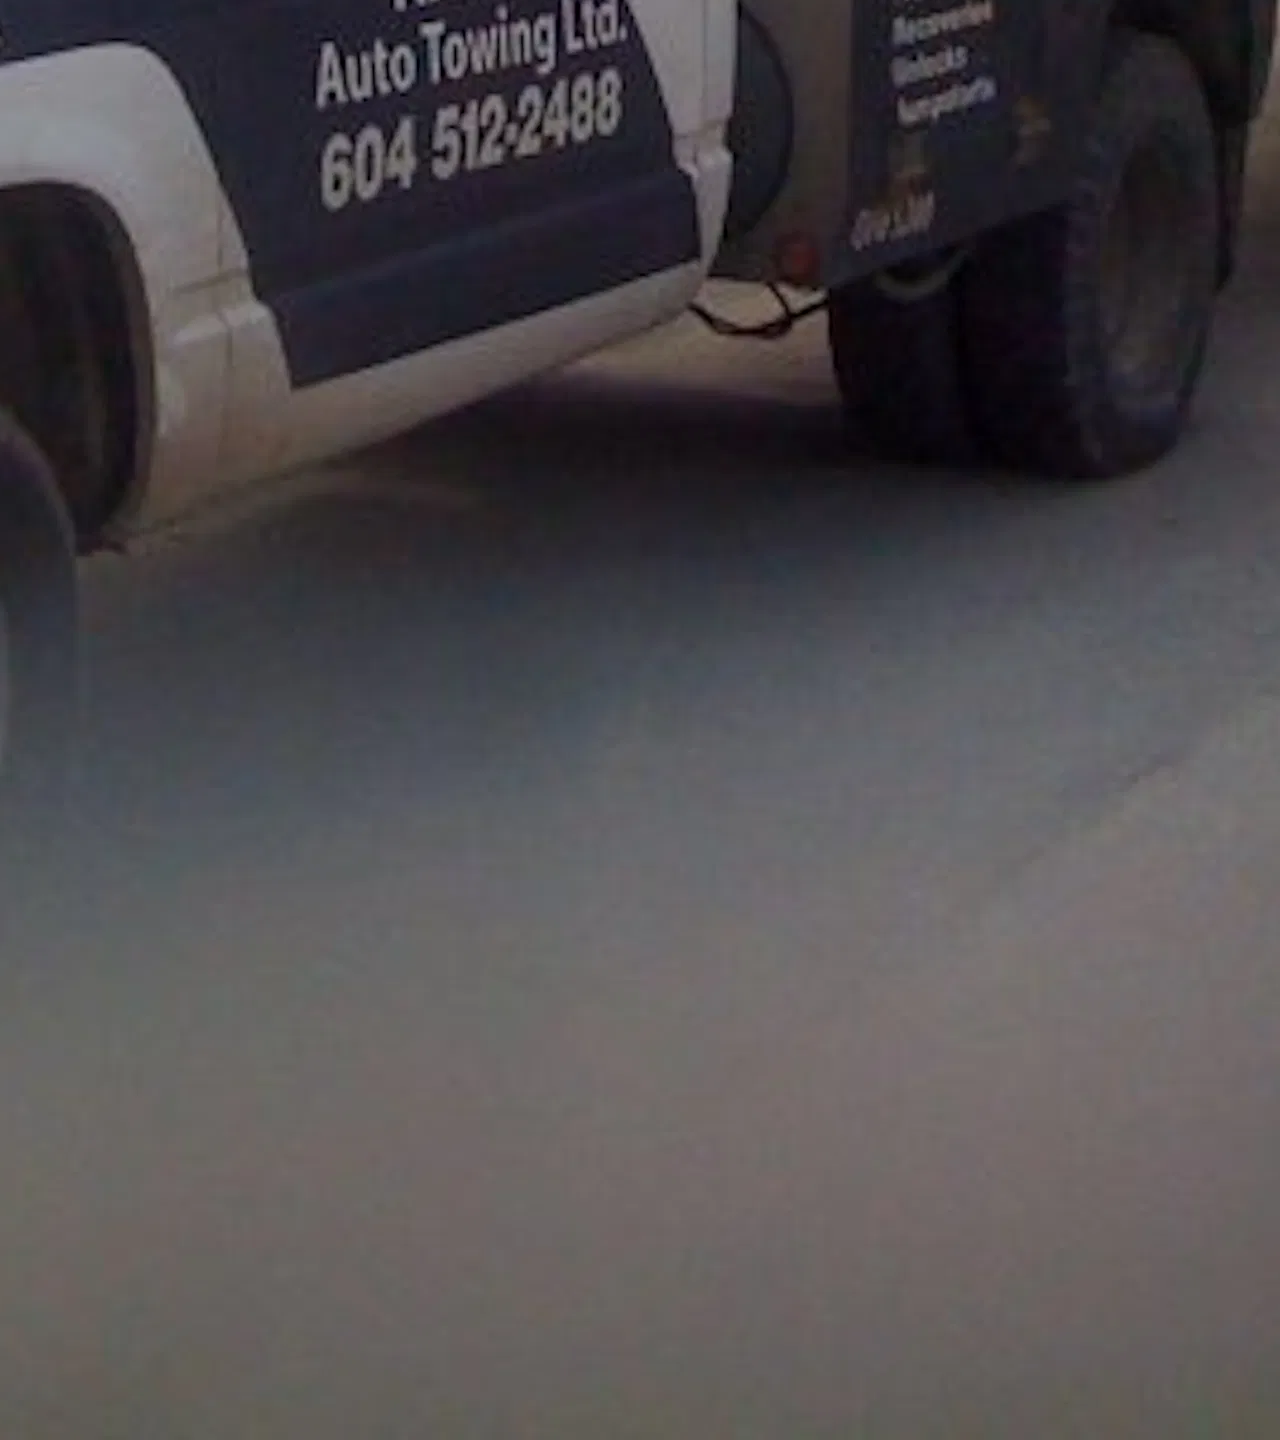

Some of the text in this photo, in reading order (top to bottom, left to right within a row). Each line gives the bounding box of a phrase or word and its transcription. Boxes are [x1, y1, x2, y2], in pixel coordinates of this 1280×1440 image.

[316, 37, 418, 109] Auto
[420, 7, 556, 86] Towing
[320, 114, 418, 212] 604
